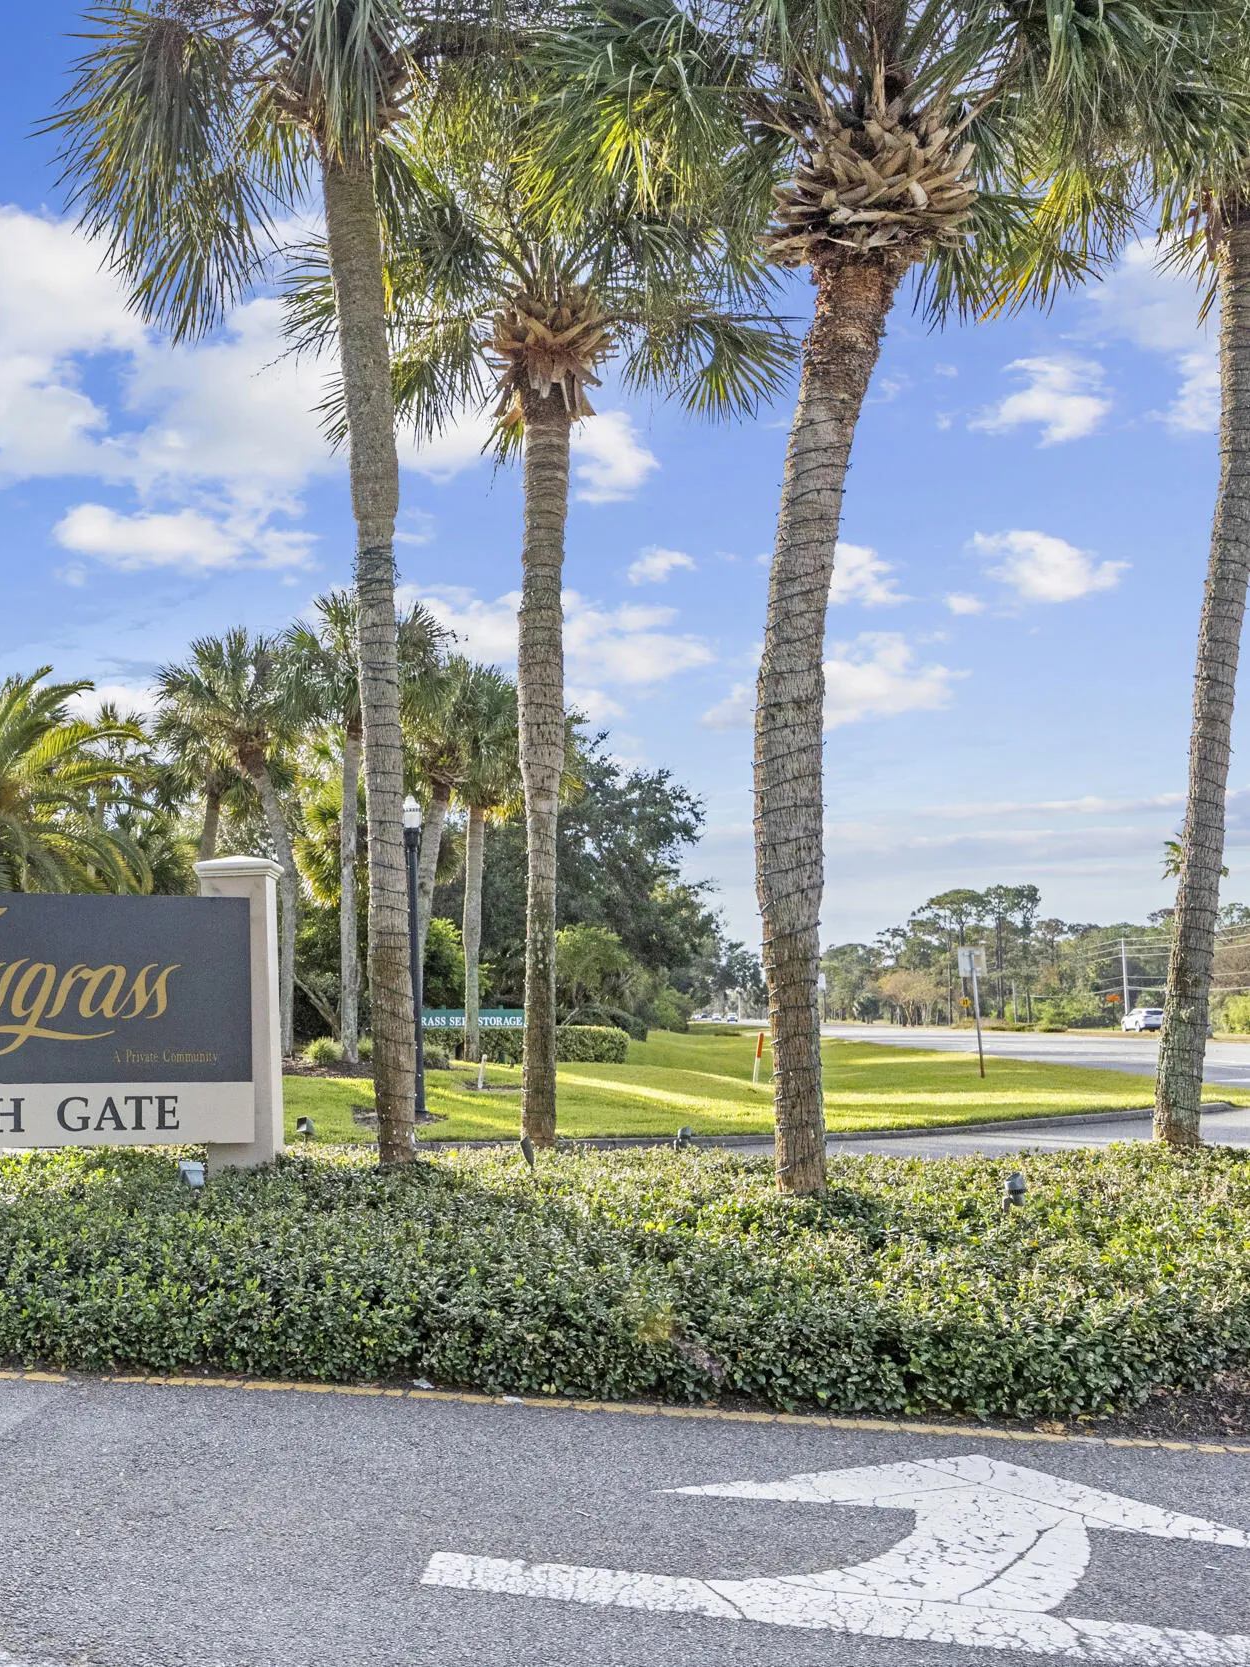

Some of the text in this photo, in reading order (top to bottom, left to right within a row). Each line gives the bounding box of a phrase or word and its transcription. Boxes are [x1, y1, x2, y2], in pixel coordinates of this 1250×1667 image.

[421, 1016, 447, 1027] RASS
[478, 1016, 523, 1027] STORAGE
[113, 1049, 219, 1065] A Private Community
[56, 1095, 181, 1131] GATE
